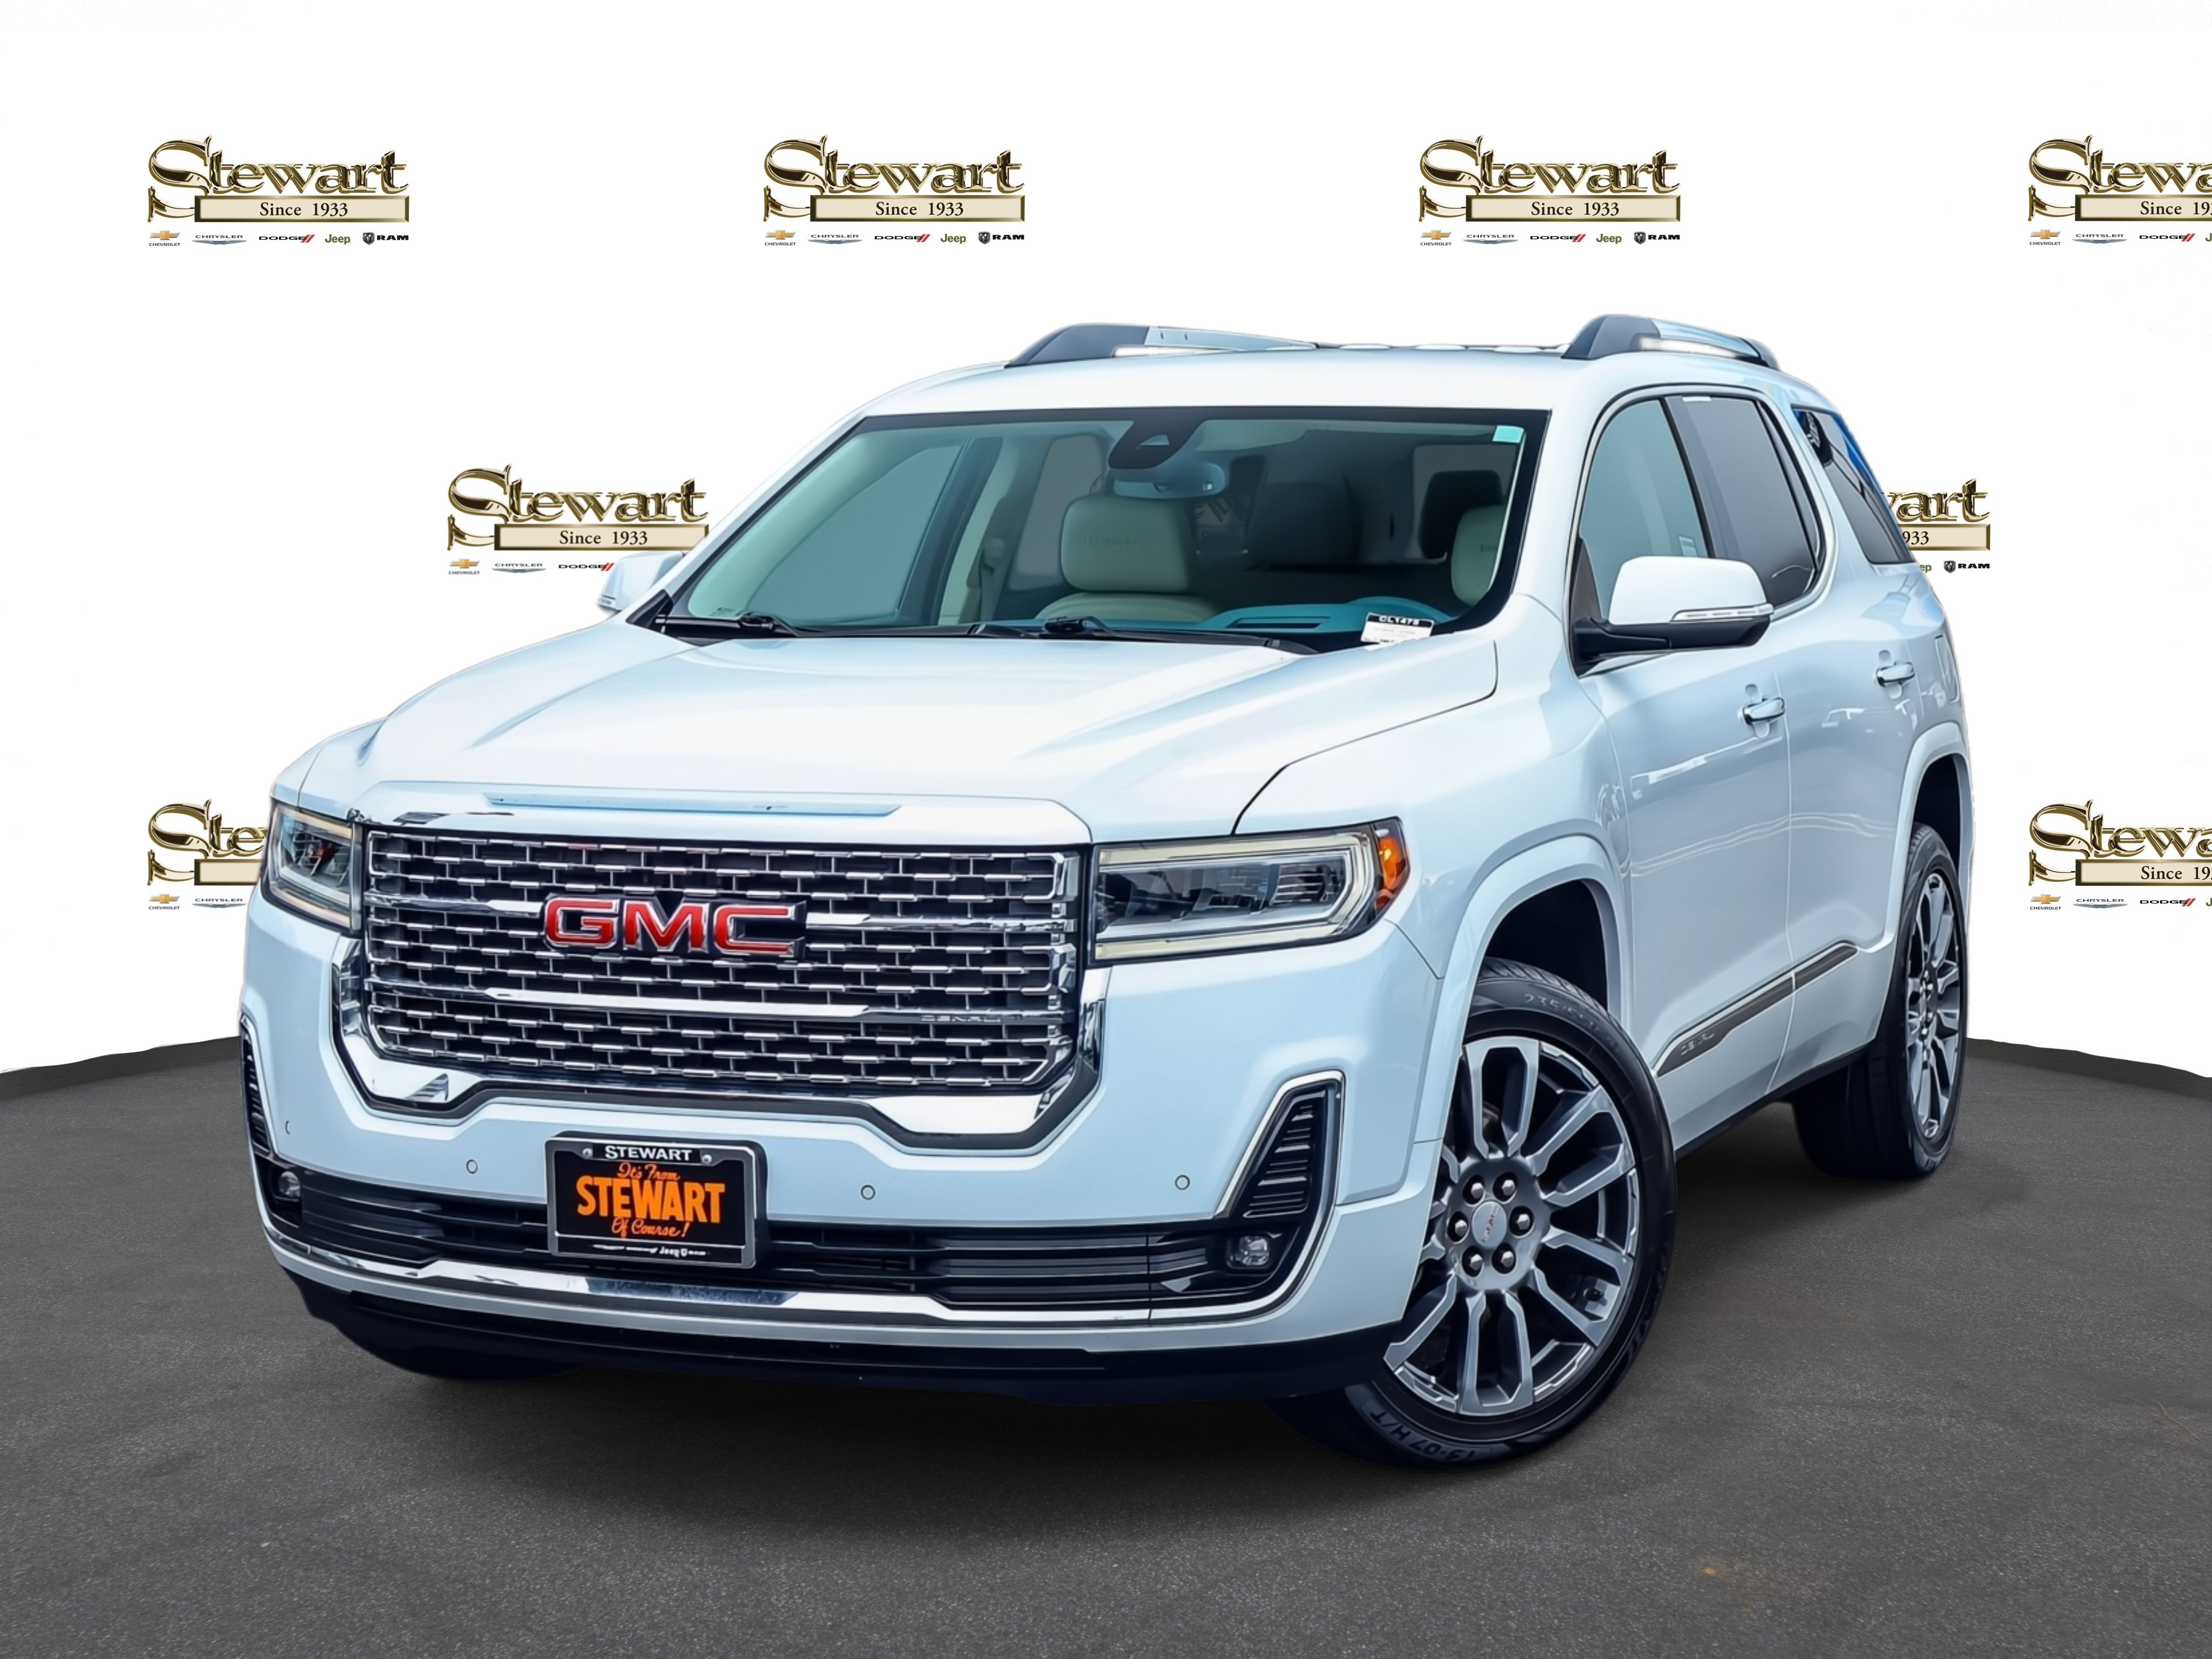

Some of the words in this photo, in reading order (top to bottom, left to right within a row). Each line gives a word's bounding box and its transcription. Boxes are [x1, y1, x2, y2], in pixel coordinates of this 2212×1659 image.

[543, 895, 806, 957] GMC
[604, 1145, 692, 1161] STEWART
[576, 1176, 725, 1223] STEWART
[611, 1218, 629, 1238] Of
